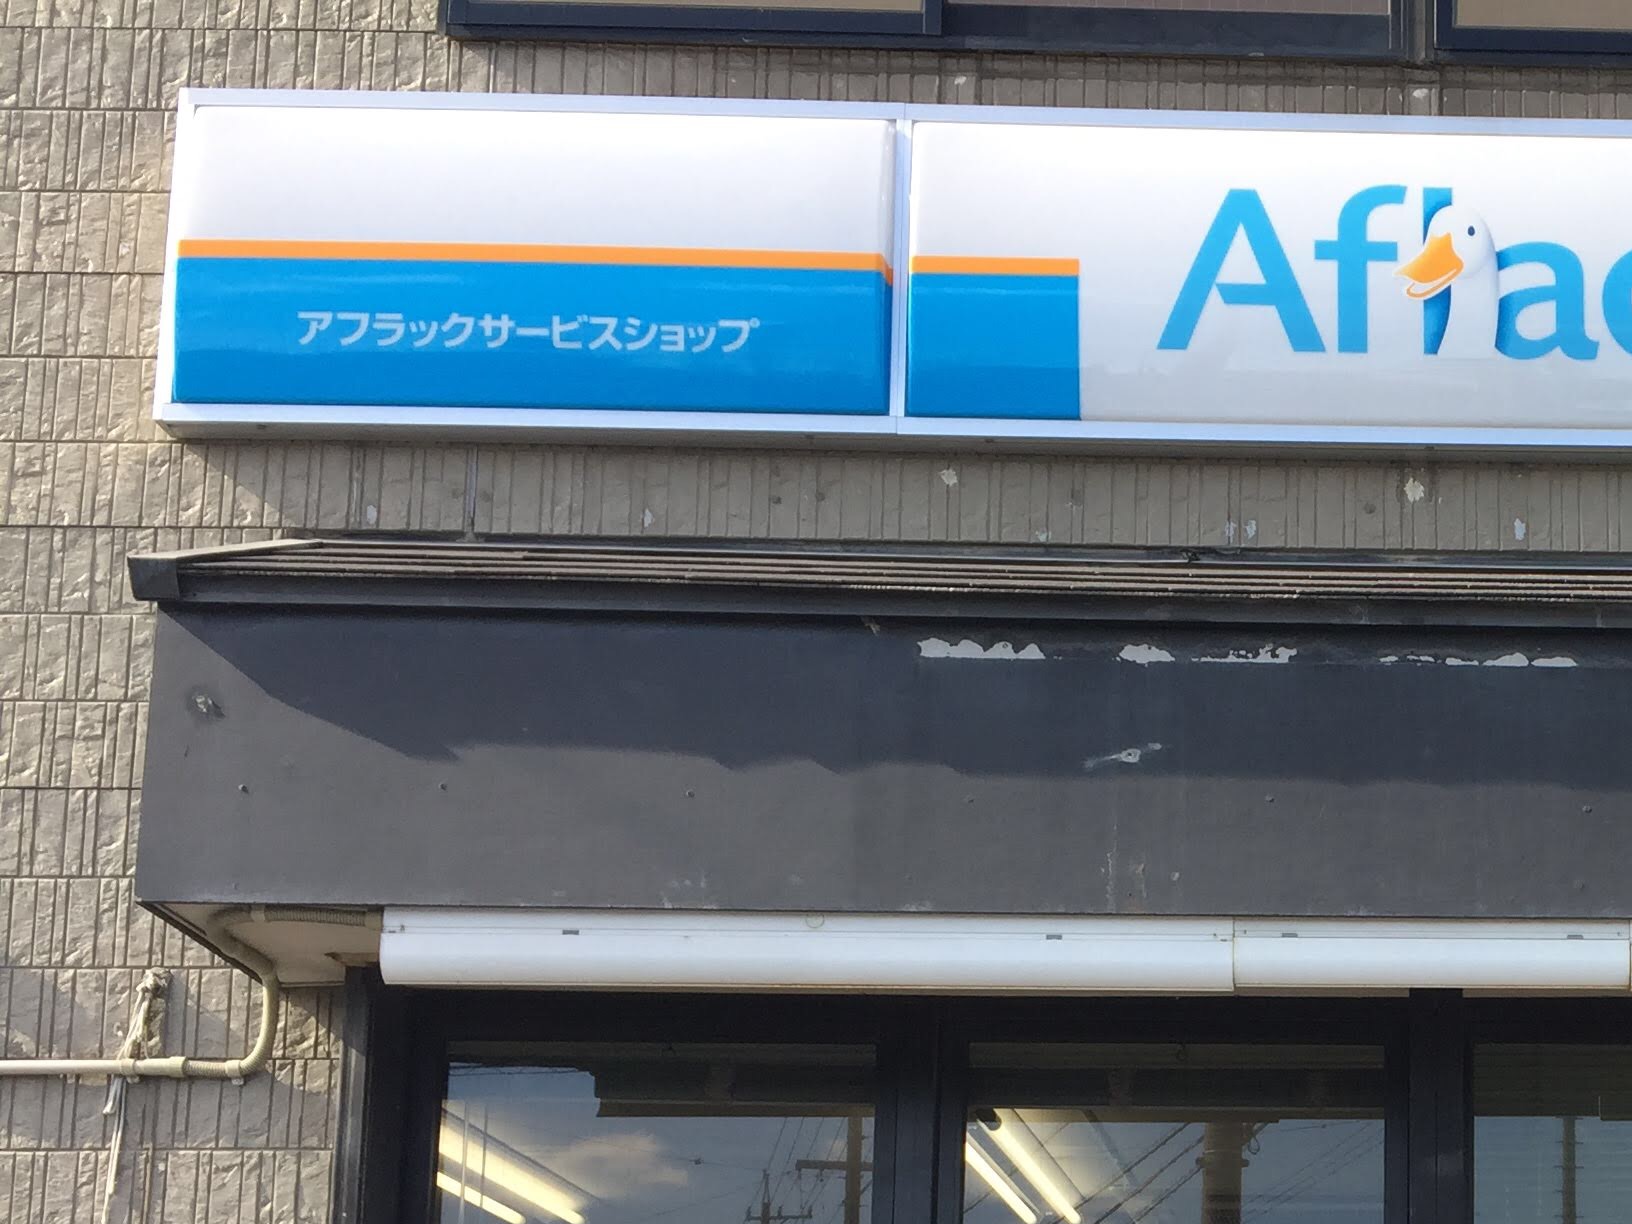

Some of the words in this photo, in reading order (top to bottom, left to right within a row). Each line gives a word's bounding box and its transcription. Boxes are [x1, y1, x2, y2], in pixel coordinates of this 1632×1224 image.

[297, 310, 761, 353] アフラックサービスショップ
